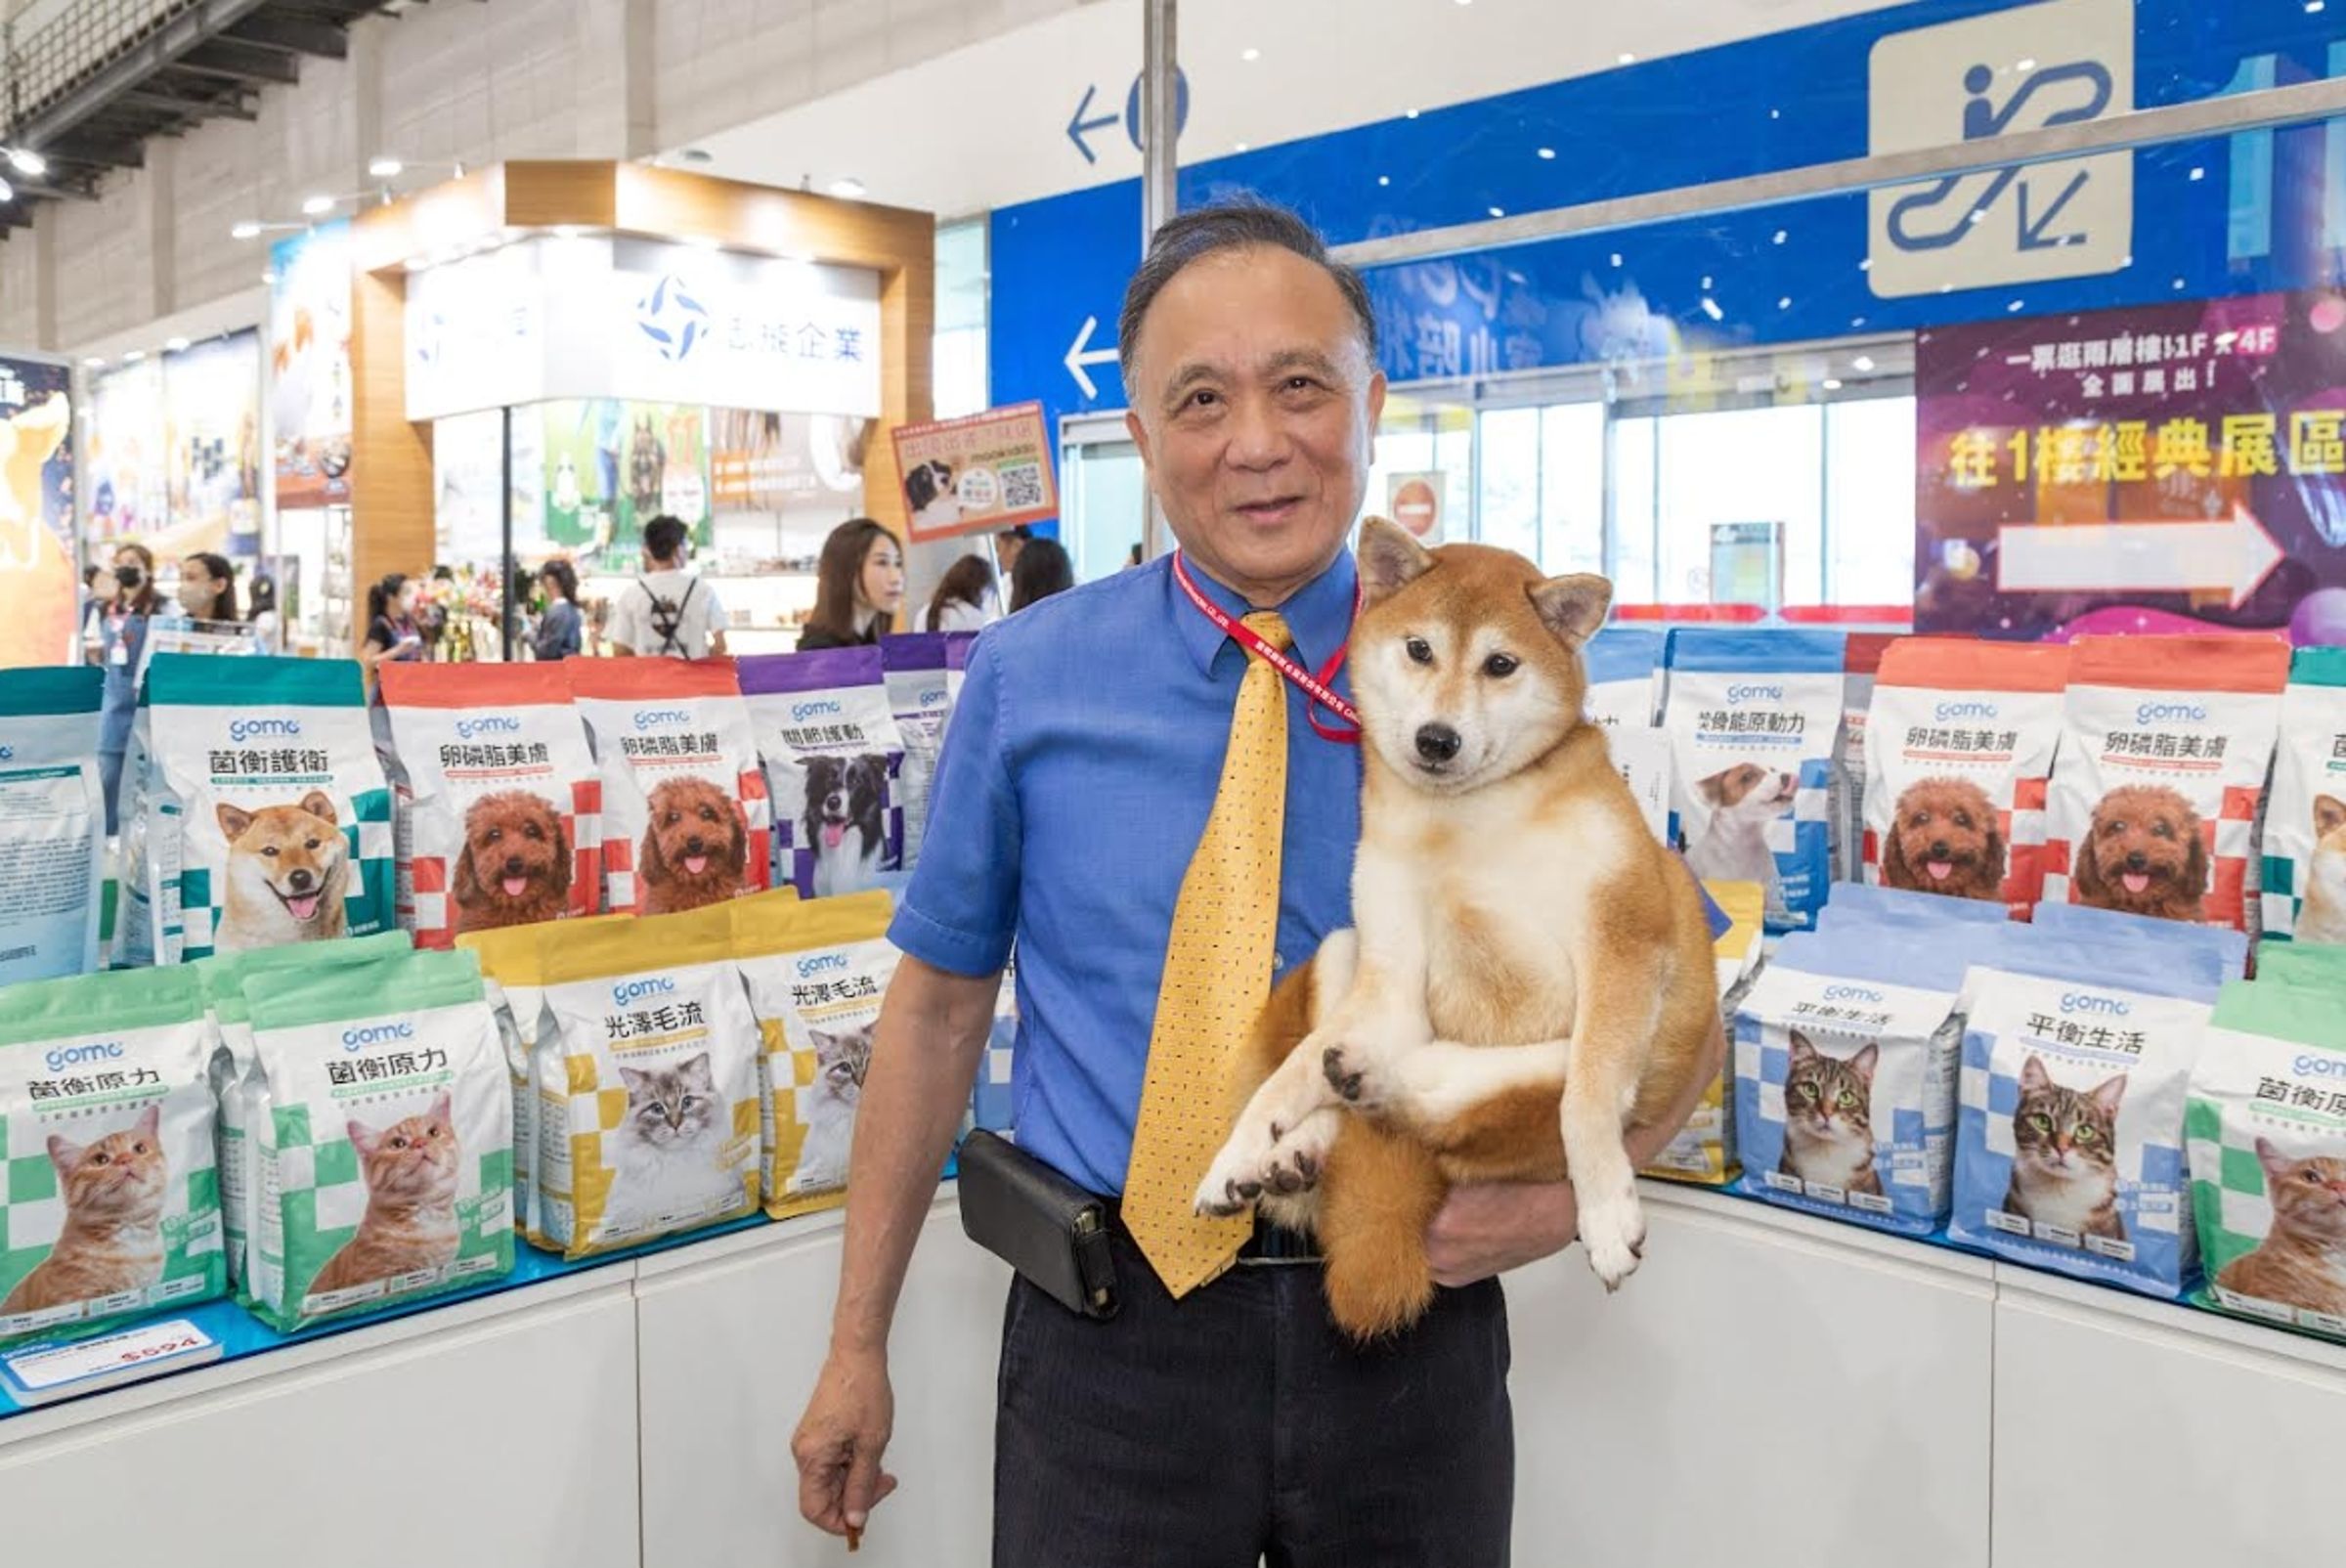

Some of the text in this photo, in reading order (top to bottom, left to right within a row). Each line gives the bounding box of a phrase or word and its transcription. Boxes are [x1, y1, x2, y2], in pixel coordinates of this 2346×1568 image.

[1950, 411, 2346, 486] 往1樓經典展區
[620, 732, 719, 756] 卵磷脂美膚
[1904, 726, 2018, 751] 卵磷脂美膚
[2105, 730, 2228, 758] 卵磷脂美膚
[207, 748, 329, 774] 菌衡護衛
[439, 743, 549, 767] 卵磷脂美膚
[792, 976, 878, 1006] 光澤毛流
[604, 1000, 705, 1038] 光澤毛流
[2026, 1012, 2148, 1054] 平衡生活
[326, 1047, 448, 1085] 菌衡原力
[26, 1067, 160, 1101] 菌衡原力
[2256, 1076, 2346, 1117] 菌衡原
